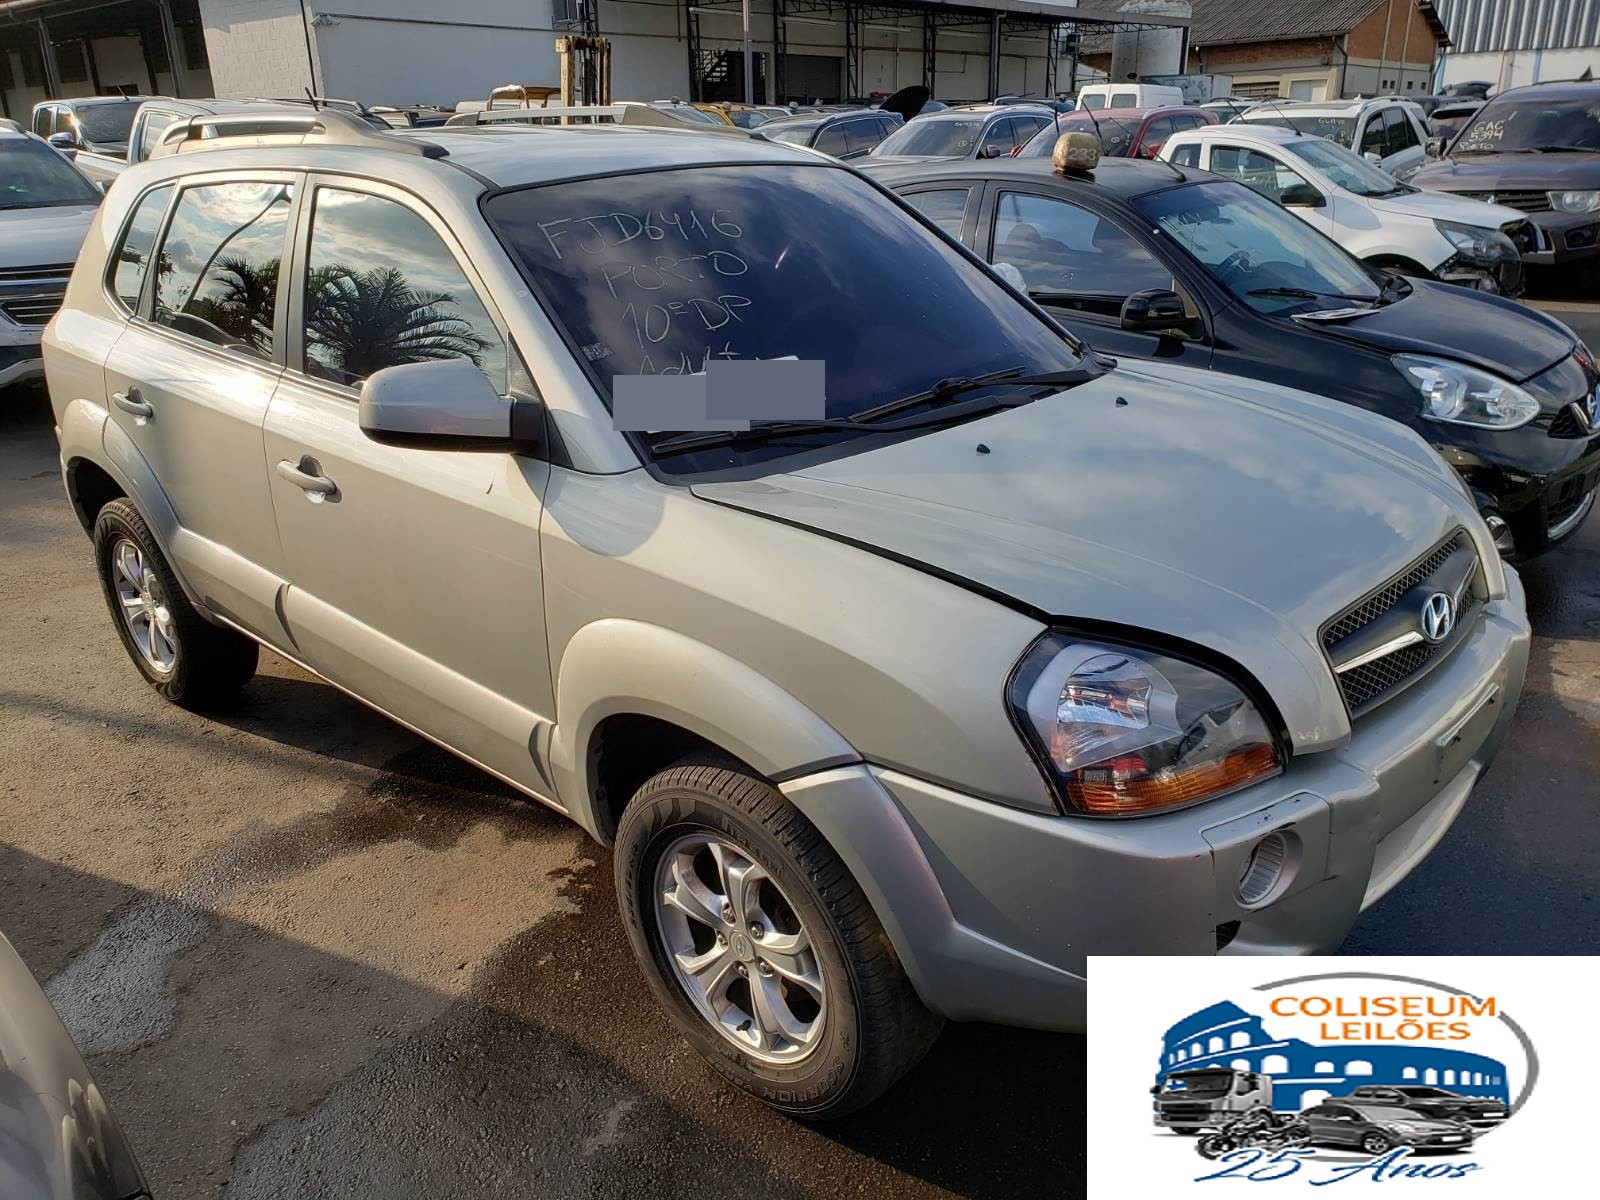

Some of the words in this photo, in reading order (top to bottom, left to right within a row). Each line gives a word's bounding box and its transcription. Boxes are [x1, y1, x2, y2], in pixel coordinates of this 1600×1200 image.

[1474, 119, 1505, 132] GAC
[537, 205, 743, 260] FJD6416
[601, 250, 749, 300] PORTO
